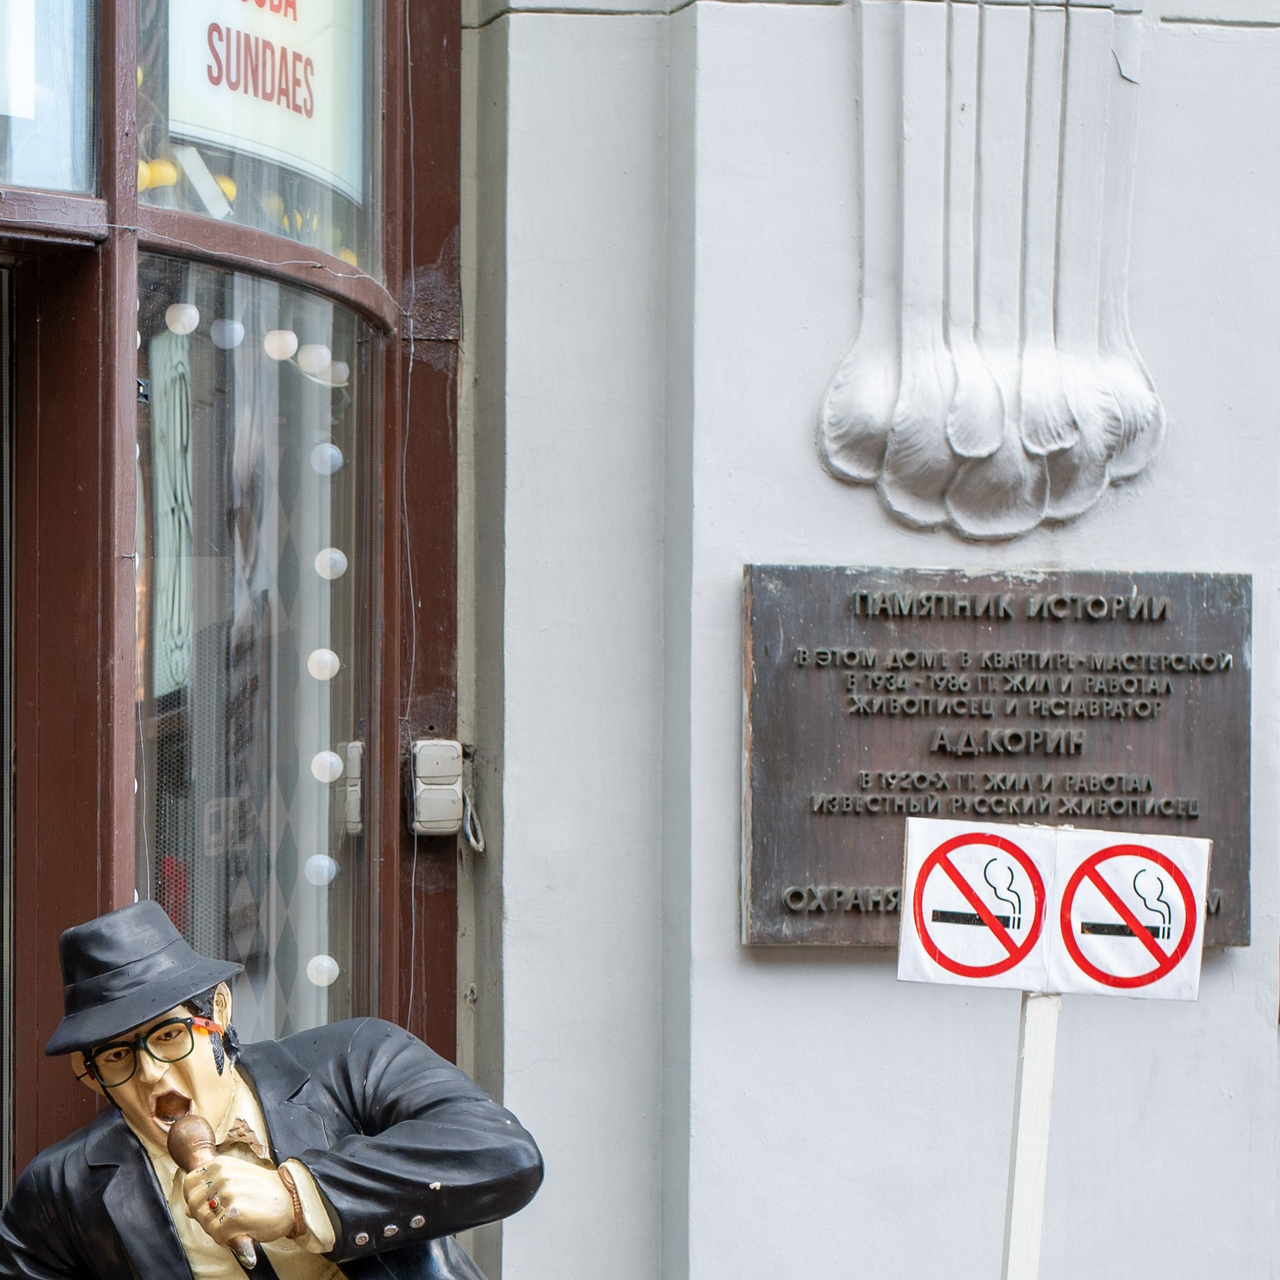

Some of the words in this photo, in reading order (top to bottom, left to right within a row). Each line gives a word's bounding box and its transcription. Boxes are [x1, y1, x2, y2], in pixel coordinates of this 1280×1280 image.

[206, 22, 315, 119] SUNDAES
[854, 591, 1015, 618] ПАМЯТНИК
[1026, 593, 1170, 620] ИСТОРИИ
[797, 648, 809, 667] В
[815, 649, 878, 667] ЭТОМ
[886, 650, 949, 669] ДОМЕ
[960, 651, 971, 668] В
[847, 672, 859, 690] В
[1003, 674, 1052, 692] ЖИЛ
[1061, 675, 1073, 692] И
[1085, 675, 1174, 694] РАБОТАЛ
[848, 696, 994, 717] ЖИВОПИСЕЦ
[1005, 698, 1019, 716] И
[1028, 699, 1163, 717] РЕСТАВРАТОР
[859, 770, 871, 789] В
[984, 772, 1033, 790] ЖИЛ
[1040, 773, 1054, 791] И
[1064, 773, 1153, 792] РАБОТАЛ
[810, 793, 941, 814] ИЗВЕСТНЫЙ
[950, 794, 1052, 815] РУССКИЙ
[1058, 797, 1200, 818] ЖИВОПИСЕЦ
